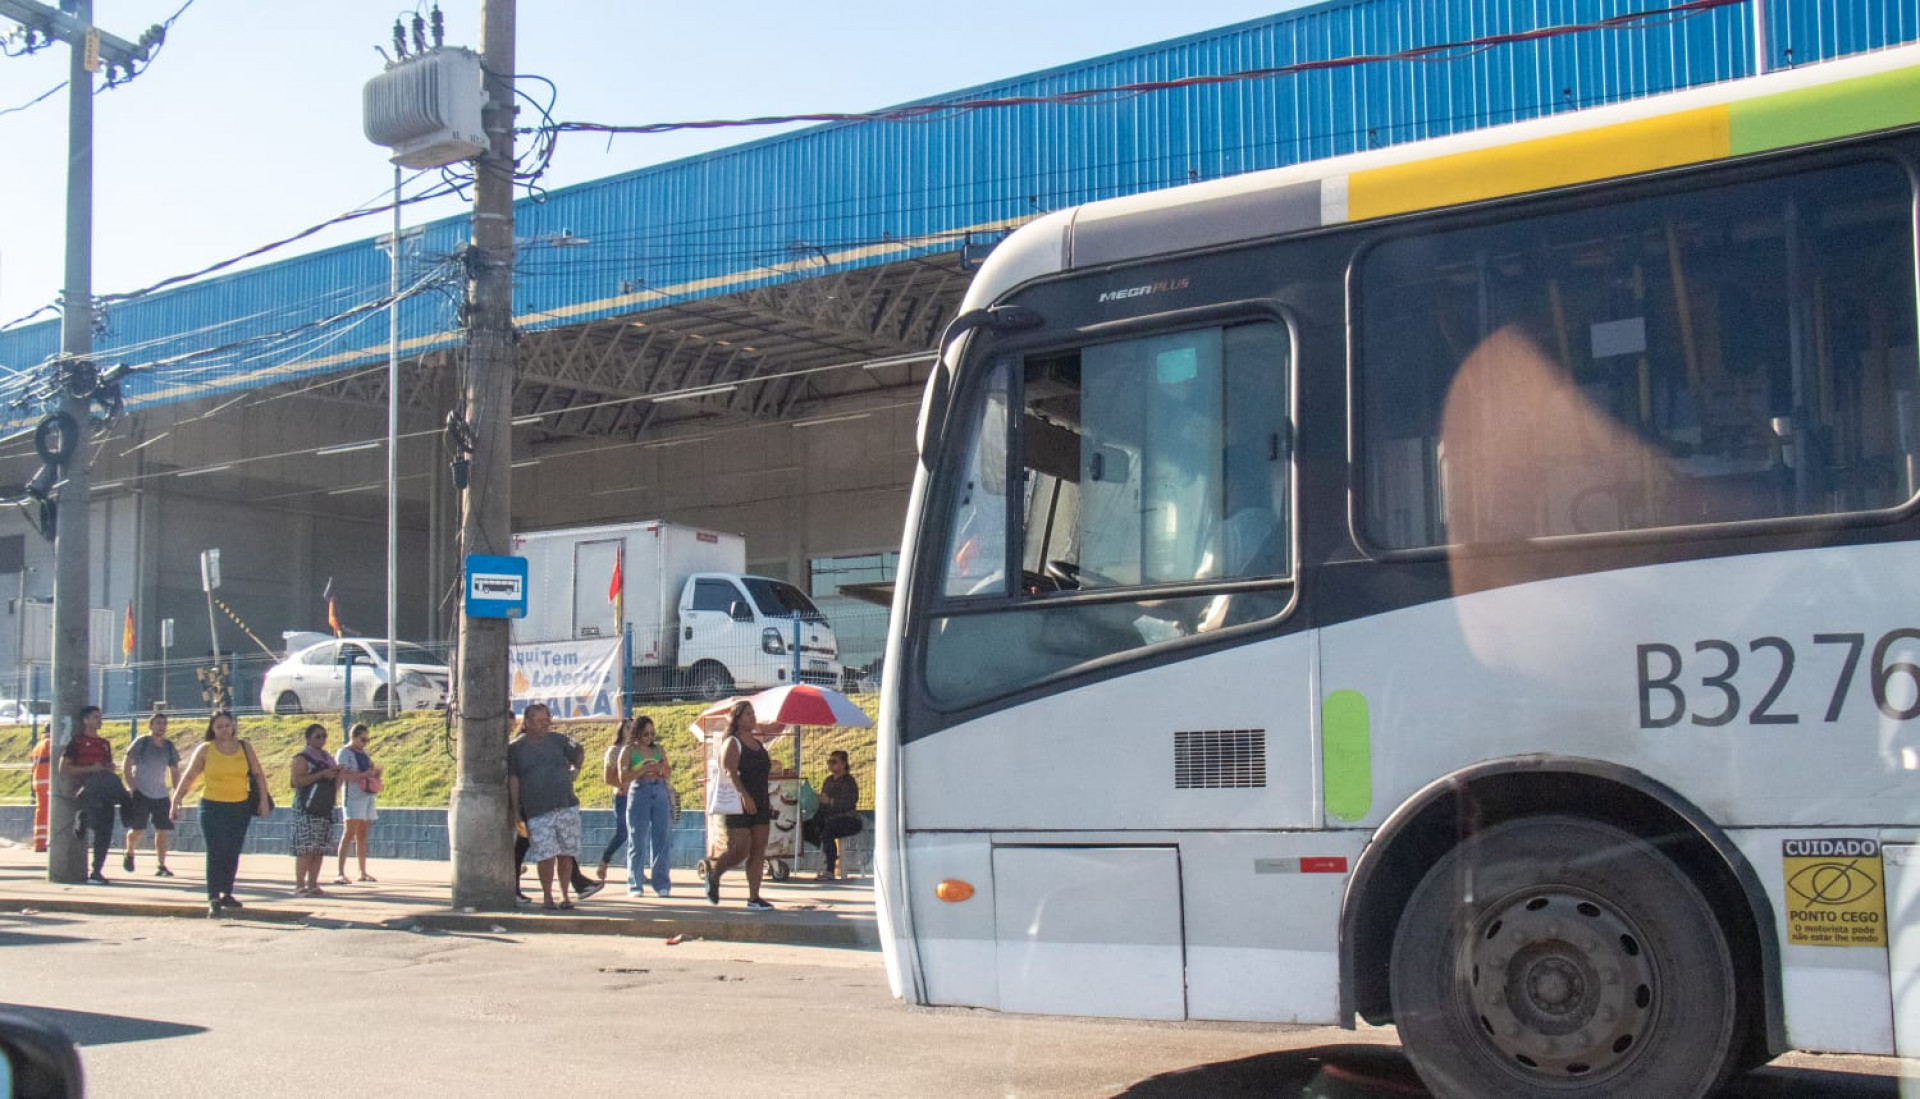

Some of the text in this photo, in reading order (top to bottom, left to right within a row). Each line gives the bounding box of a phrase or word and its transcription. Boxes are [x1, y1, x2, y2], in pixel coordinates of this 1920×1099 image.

[541, 650, 578, 667] Tem
[1637, 627, 1920, 729] B3276
[529, 689, 612, 718] AIXA
[1786, 841, 1875, 855] CUIDADO
[1790, 911, 1879, 923] PONTO CEGO
[1795, 924, 1875, 935] O motorista pode
[1851, 935, 1879, 943] vendo
